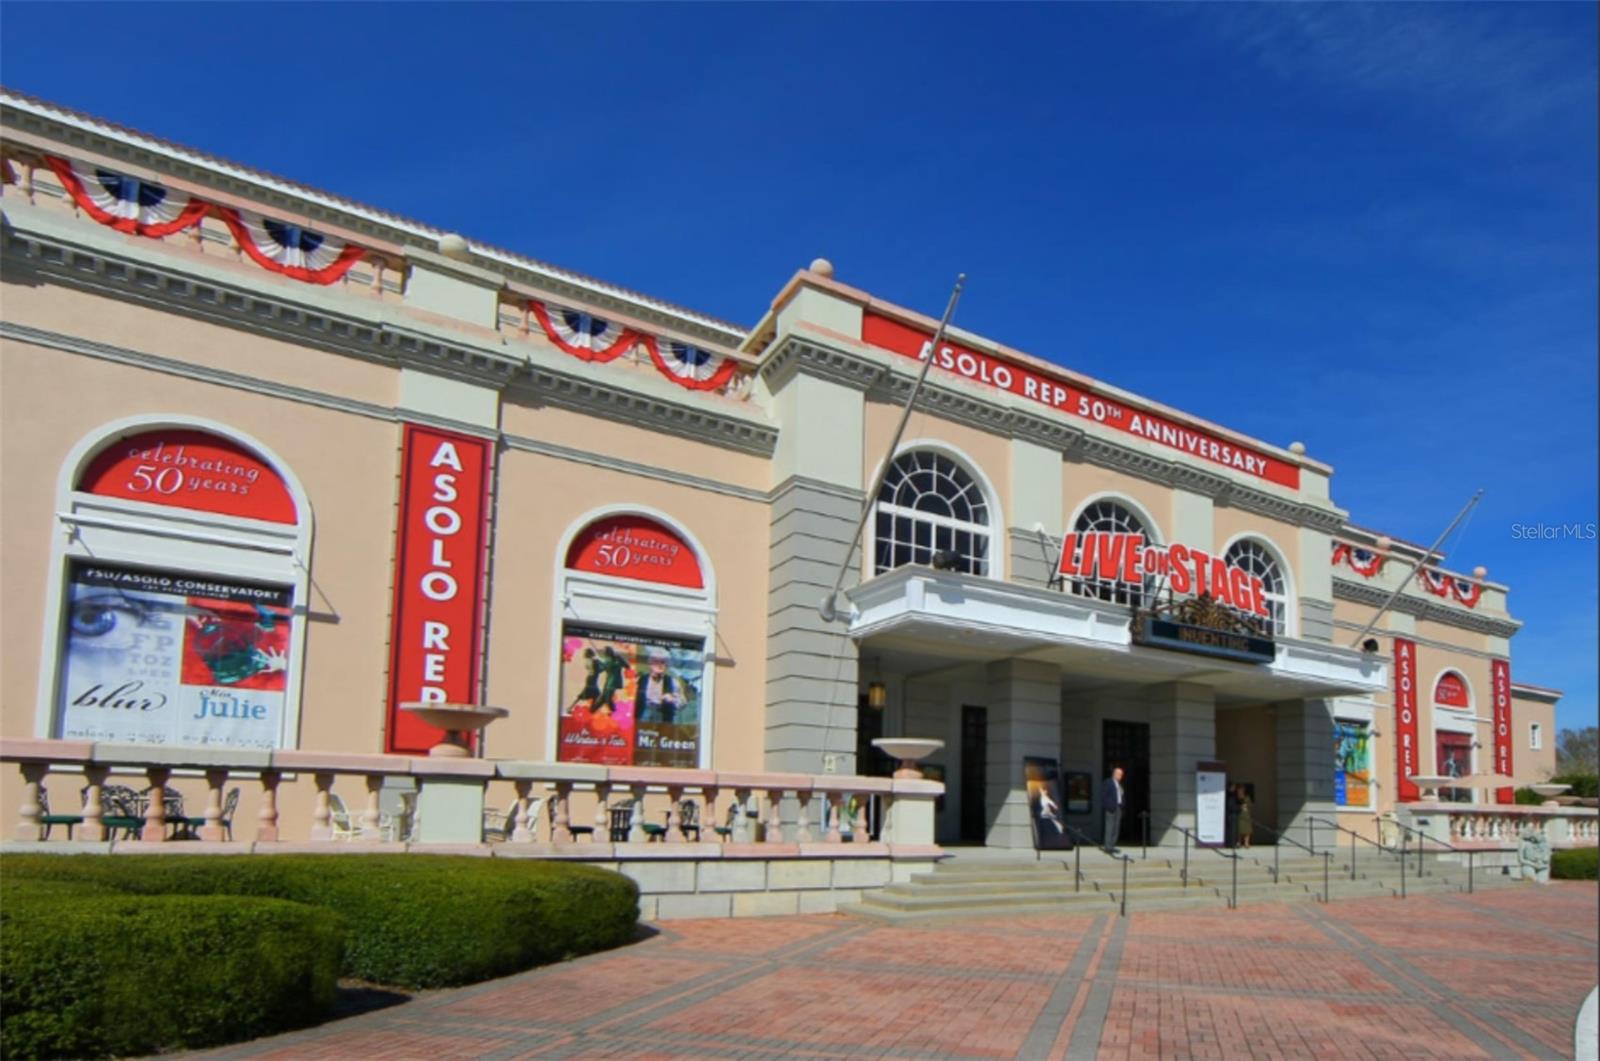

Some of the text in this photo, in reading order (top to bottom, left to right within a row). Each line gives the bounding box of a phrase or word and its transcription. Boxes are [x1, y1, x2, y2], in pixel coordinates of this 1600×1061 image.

[919, 340, 1013, 388] ASOLO
[1024, 376, 1067, 405] REP
[1130, 415, 1266, 475] ANNIVERSARY
[128, 442, 261, 482] celebrating
[127, 464, 250, 497] 50 years
[420, 441, 463, 602] ASOLO
[594, 525, 679, 556] celebrating
[594, 544, 673, 568] 50 years
[175, 578, 281, 600] CONSERVATORY
[1058, 531, 1270, 617] LIVE ON STAGE
[72, 680, 167, 712] blur
[1400, 644, 1411, 724] ASOLO
[1498, 664, 1507, 736] ASOLO
[193, 696, 267, 720] Julie
[660, 736, 696, 749] Green
